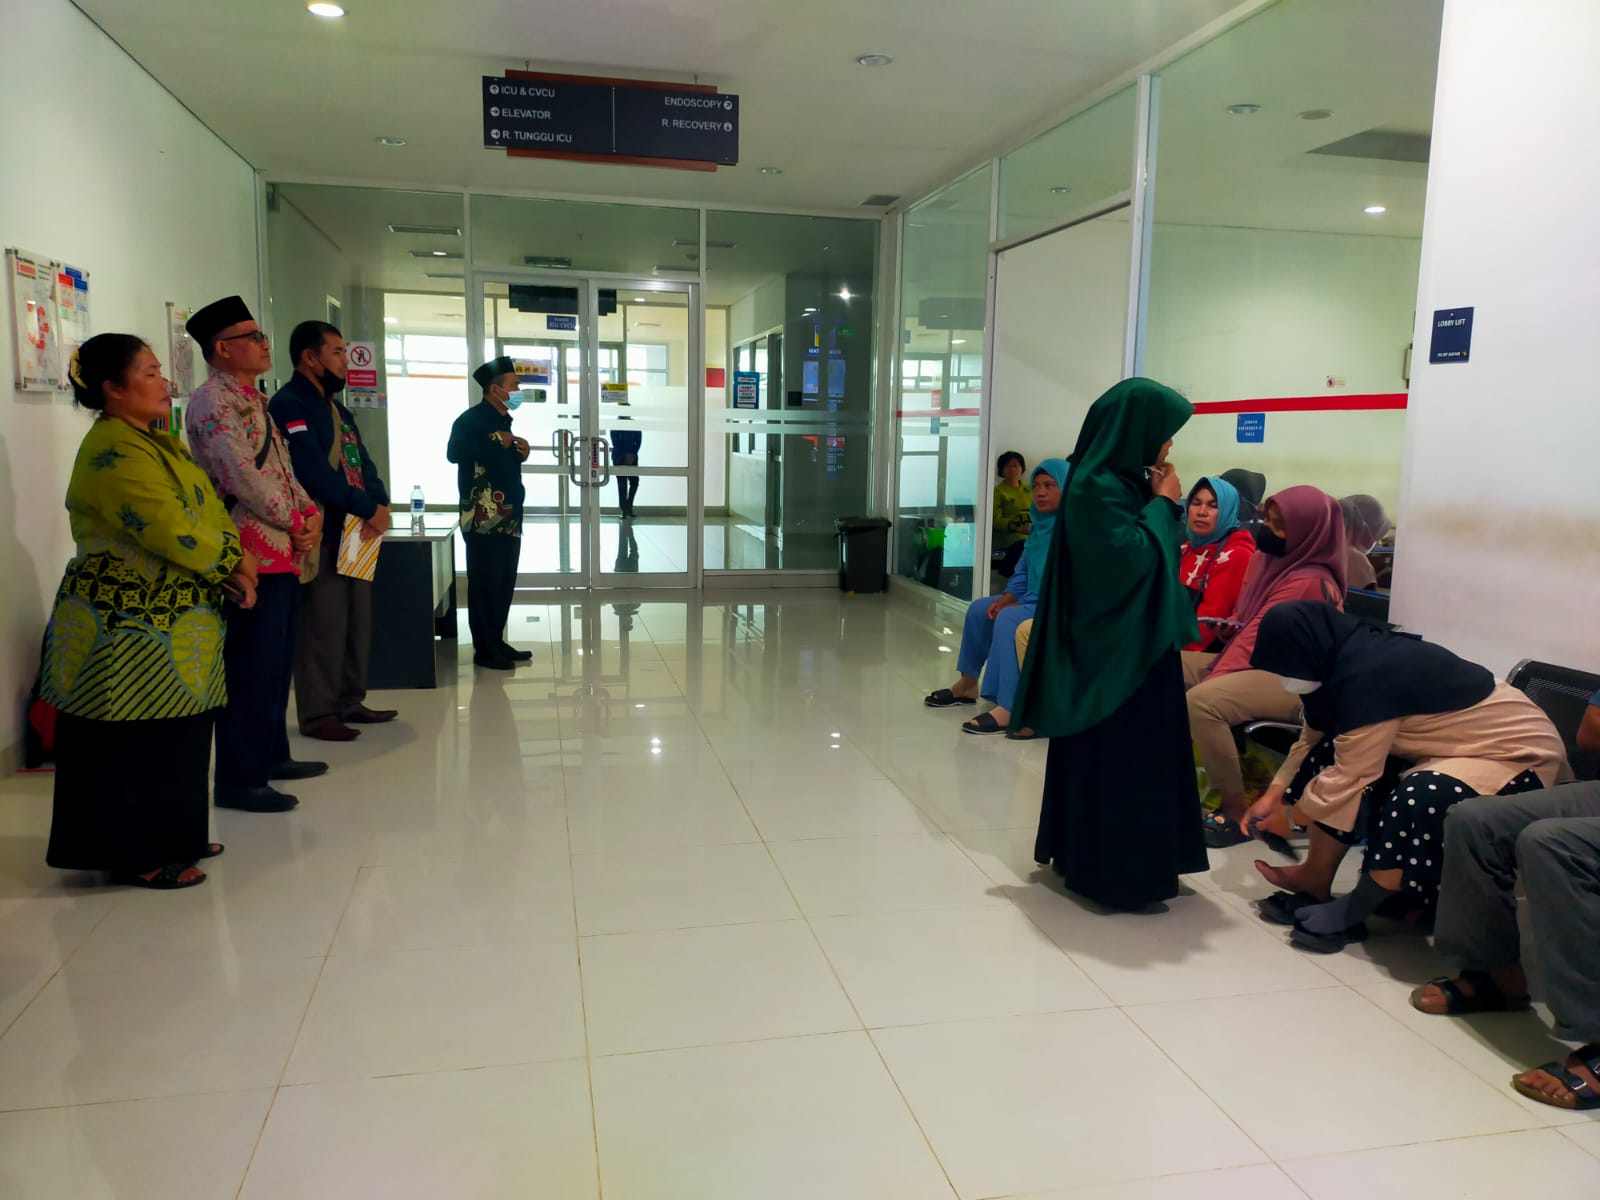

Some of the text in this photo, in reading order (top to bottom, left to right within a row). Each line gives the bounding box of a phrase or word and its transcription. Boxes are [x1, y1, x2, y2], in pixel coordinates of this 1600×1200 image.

[501, 86, 556, 98] ICU & CVCU
[664, 96, 722, 109] ENDOSCOPY
[502, 108, 552, 120] ELEVATOR
[661, 118, 722, 131] R. RECOVERY
[502, 130, 573, 143] R. TUNGGU ICU
